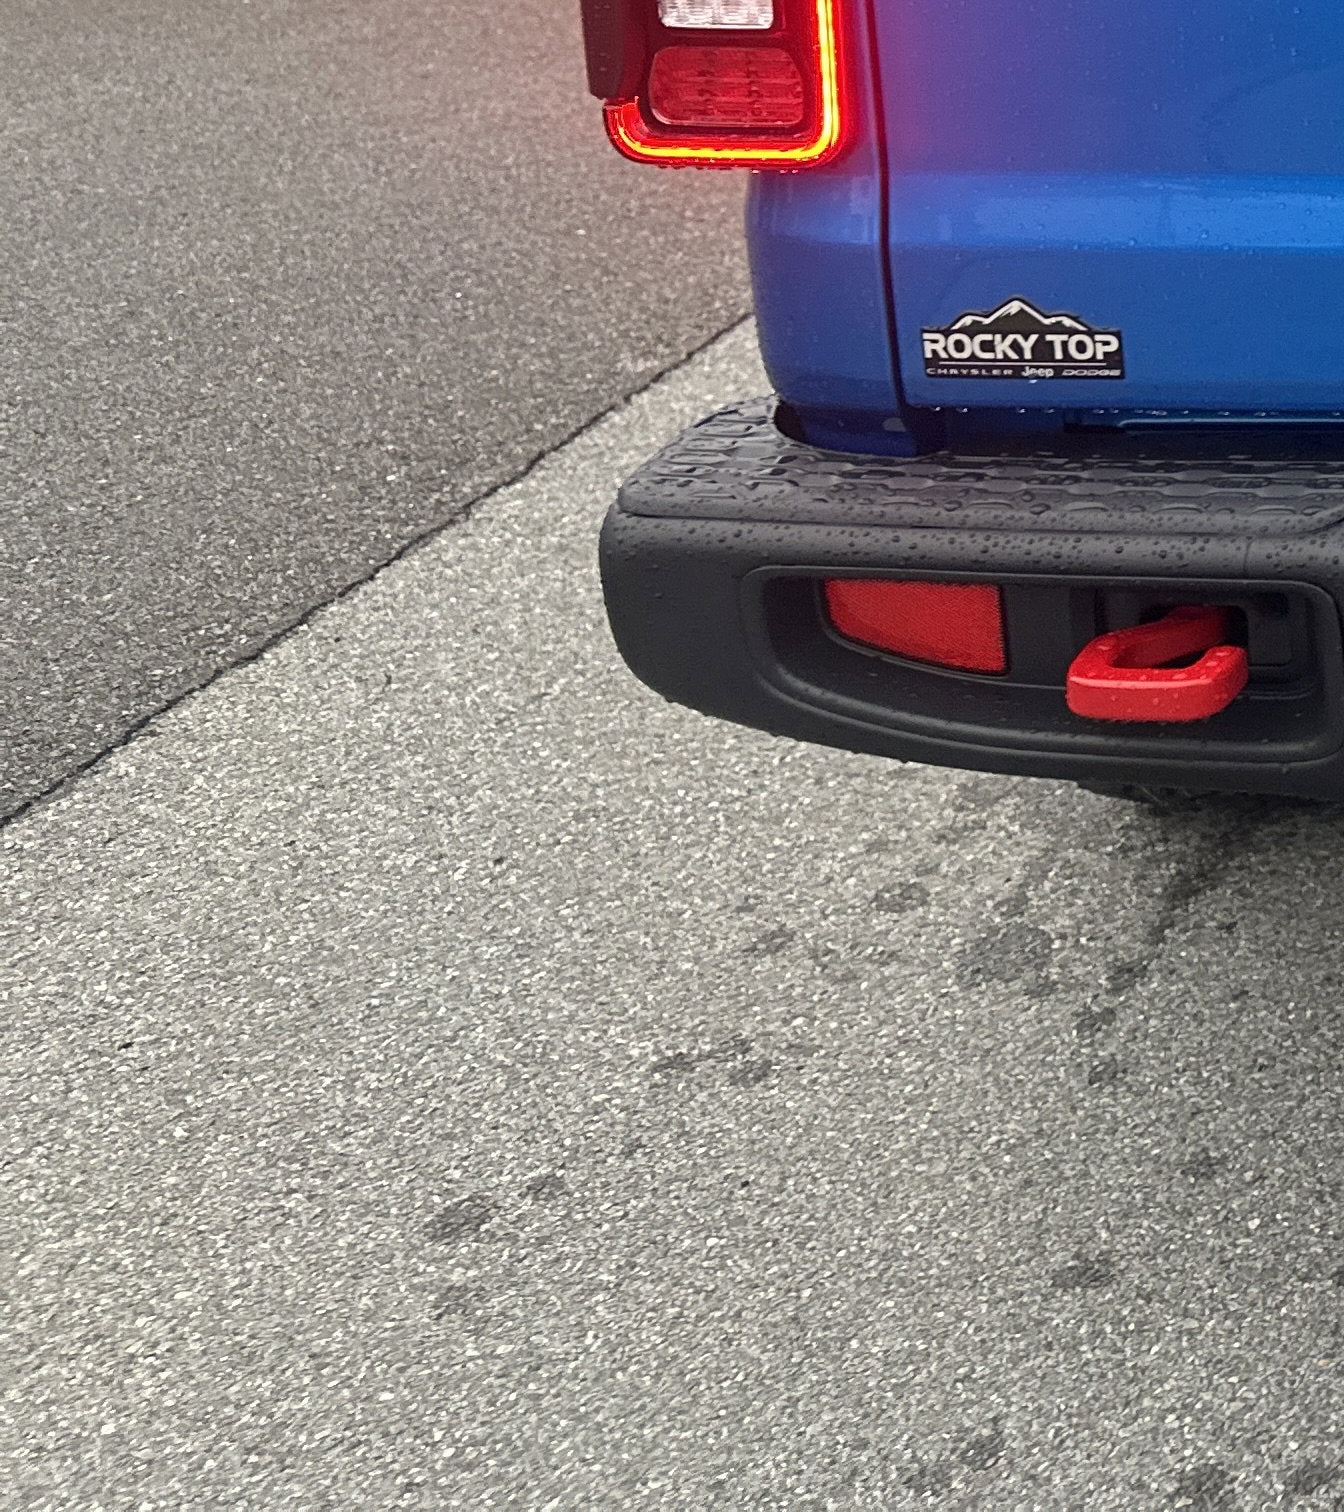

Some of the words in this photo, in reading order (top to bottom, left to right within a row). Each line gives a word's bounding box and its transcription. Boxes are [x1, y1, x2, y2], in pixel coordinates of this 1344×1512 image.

[922, 332, 1039, 360] ROCKY
[1045, 334, 1120, 361] TOP
[926, 367, 1013, 376] CHRYSLER
[1021, 365, 1055, 378] Jeep
[1062, 368, 1122, 377] DODGE
